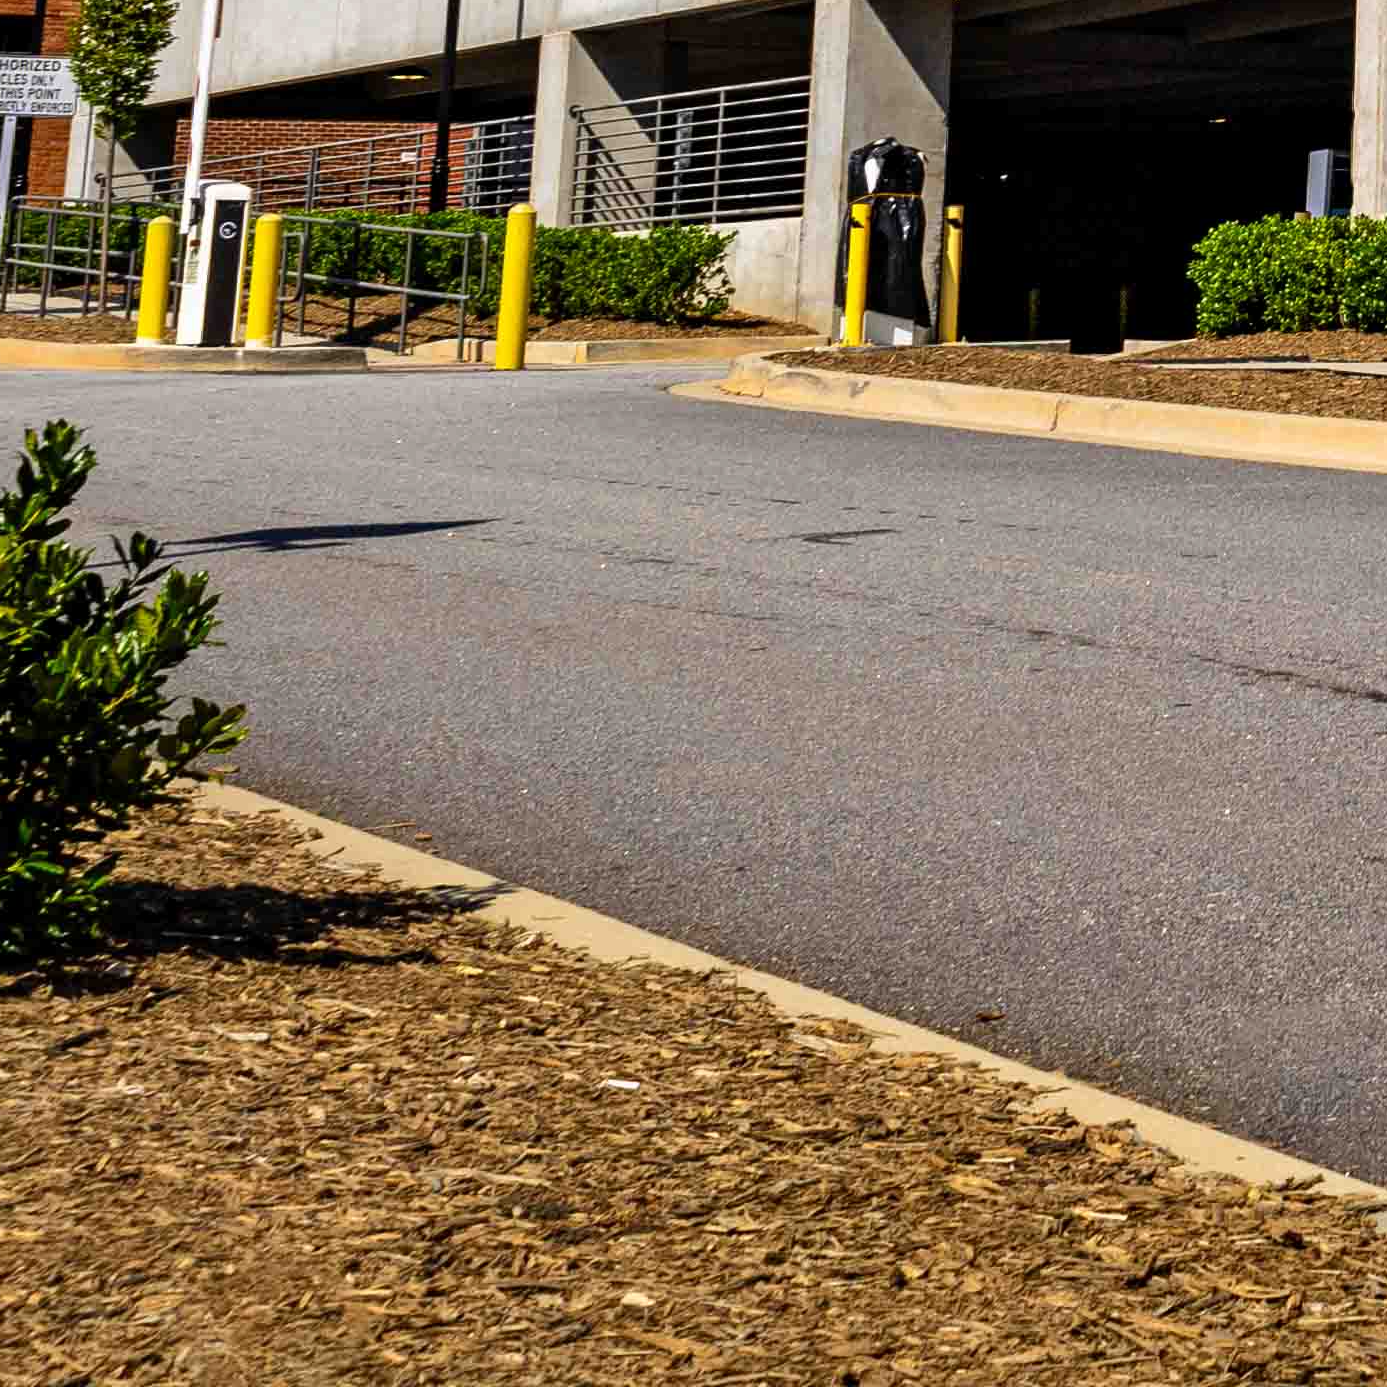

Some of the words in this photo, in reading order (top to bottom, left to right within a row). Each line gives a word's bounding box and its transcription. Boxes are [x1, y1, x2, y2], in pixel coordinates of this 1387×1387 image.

[0, 59, 61, 72] HORIZED
[31, 74, 56, 86] ONLY
[0, 87, 24, 99] THIS
[28, 88, 62, 100] POINT
